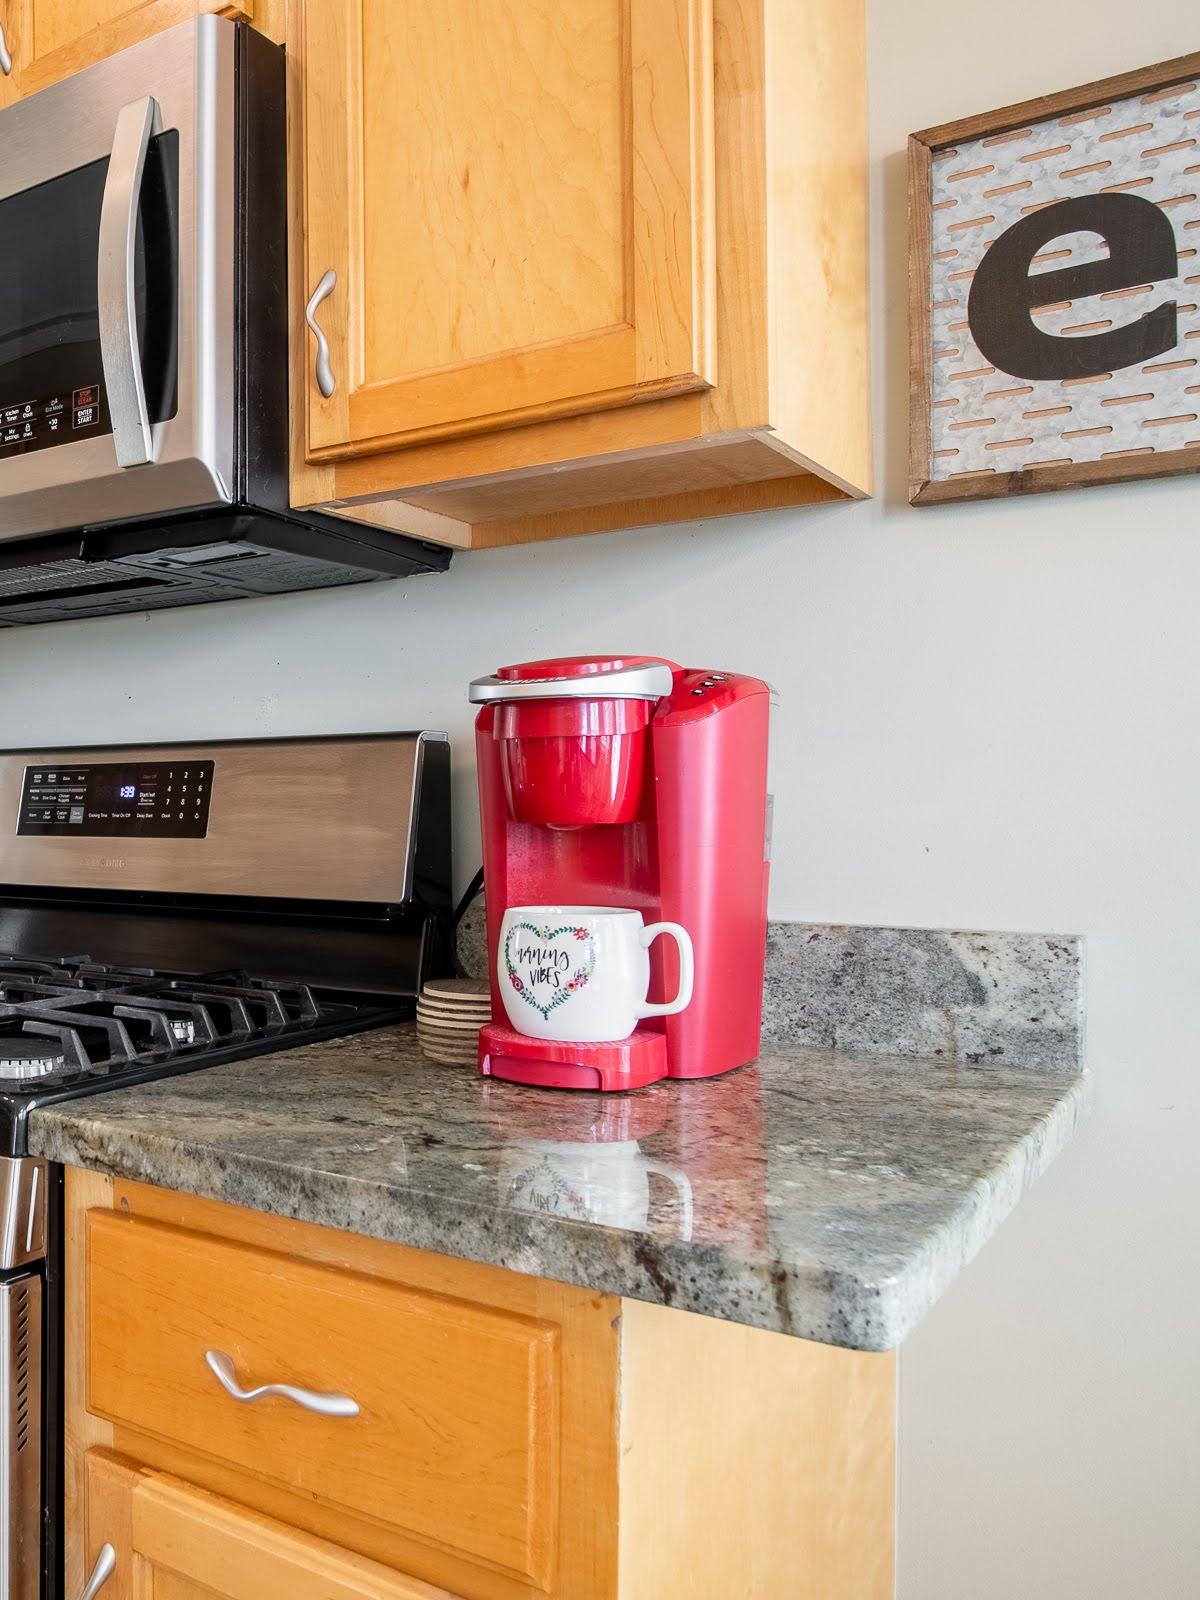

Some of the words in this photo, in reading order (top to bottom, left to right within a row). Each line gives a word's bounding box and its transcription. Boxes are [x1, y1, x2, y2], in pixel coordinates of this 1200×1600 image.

[968, 192, 1178, 381] e
[78, 408, 92, 416] ENTER
[78, 416, 92, 424] START
[530, 967, 560, 987] VIBES
